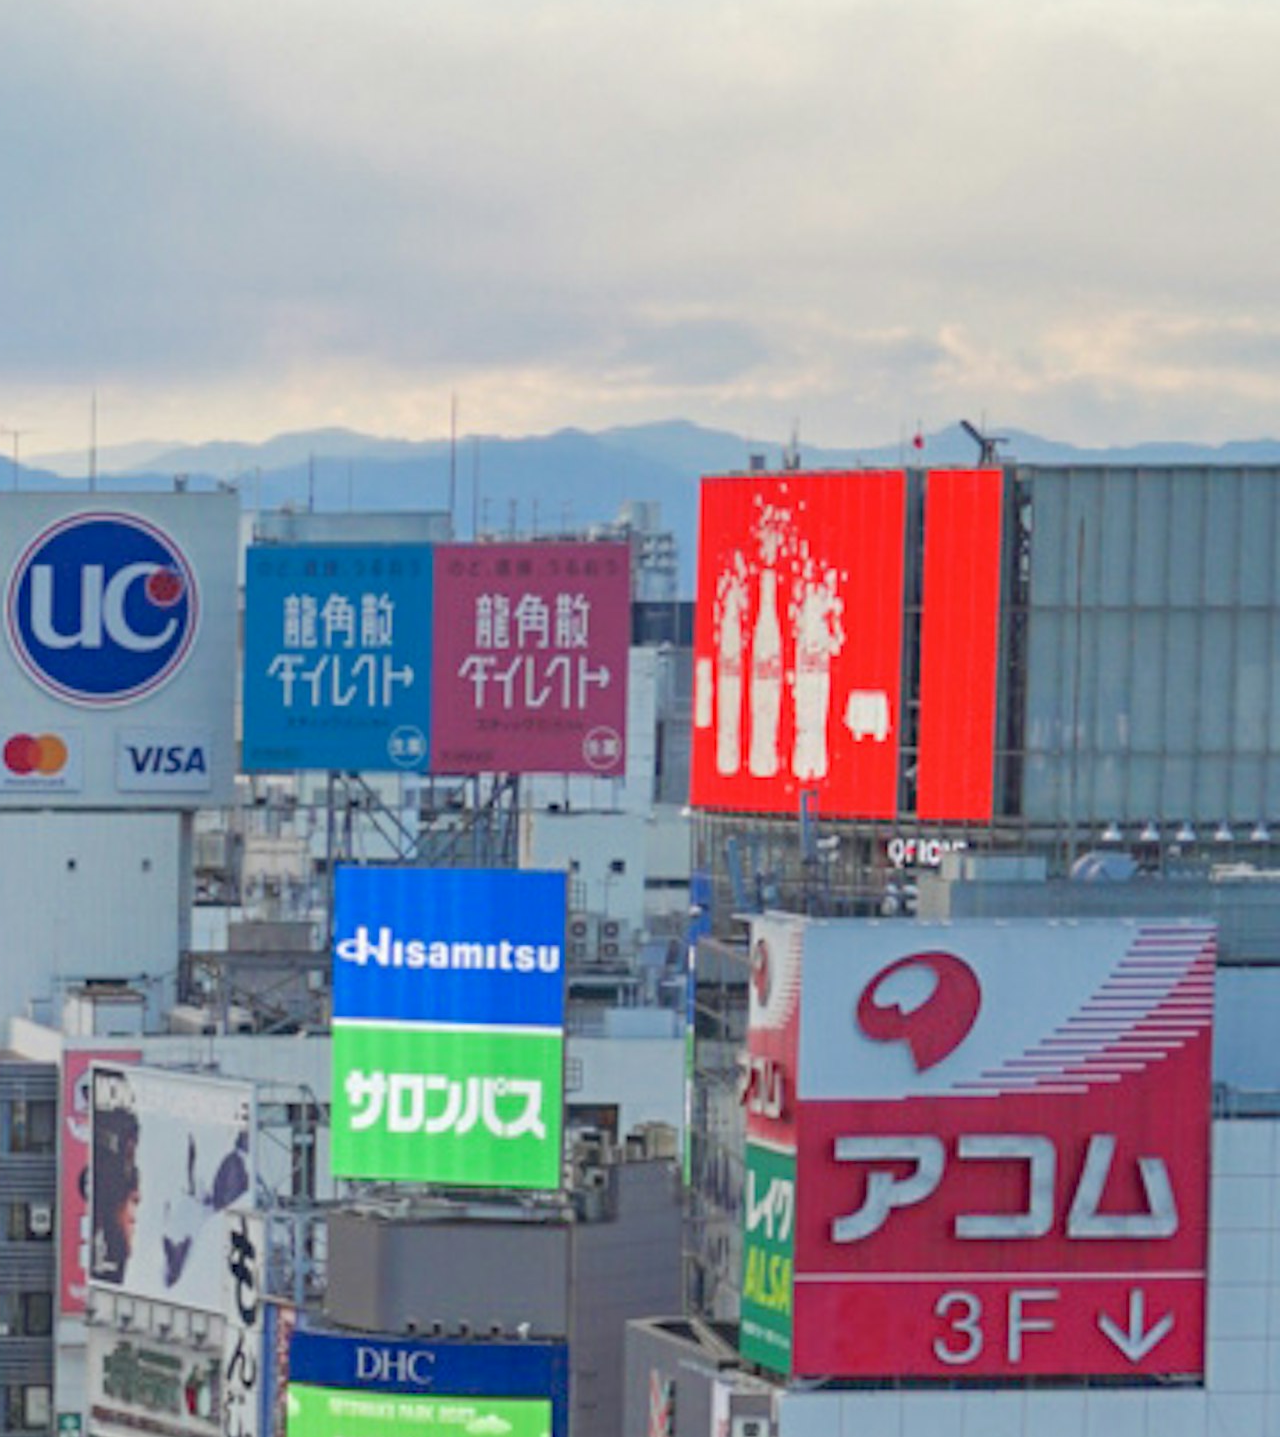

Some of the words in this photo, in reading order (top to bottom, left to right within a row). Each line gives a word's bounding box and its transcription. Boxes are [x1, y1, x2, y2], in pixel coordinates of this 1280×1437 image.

[282, 593, 395, 649] 龍角散
[474, 593, 591, 650] 龍角散
[266, 654, 415, 707] ダイレクト
[457, 655, 611, 710] ダイレクト
[125, 746, 207, 776] VISA
[336, 926, 561, 973] Hisamitsu
[345, 1070, 546, 1140] サロンパス
[745, 1168, 794, 1243] レイク
[830, 1133, 1179, 1243] アコム
[743, 1246, 791, 1311] ALSA
[933, 1288, 1061, 1364] 3F
[355, 1347, 436, 1384] DHC
